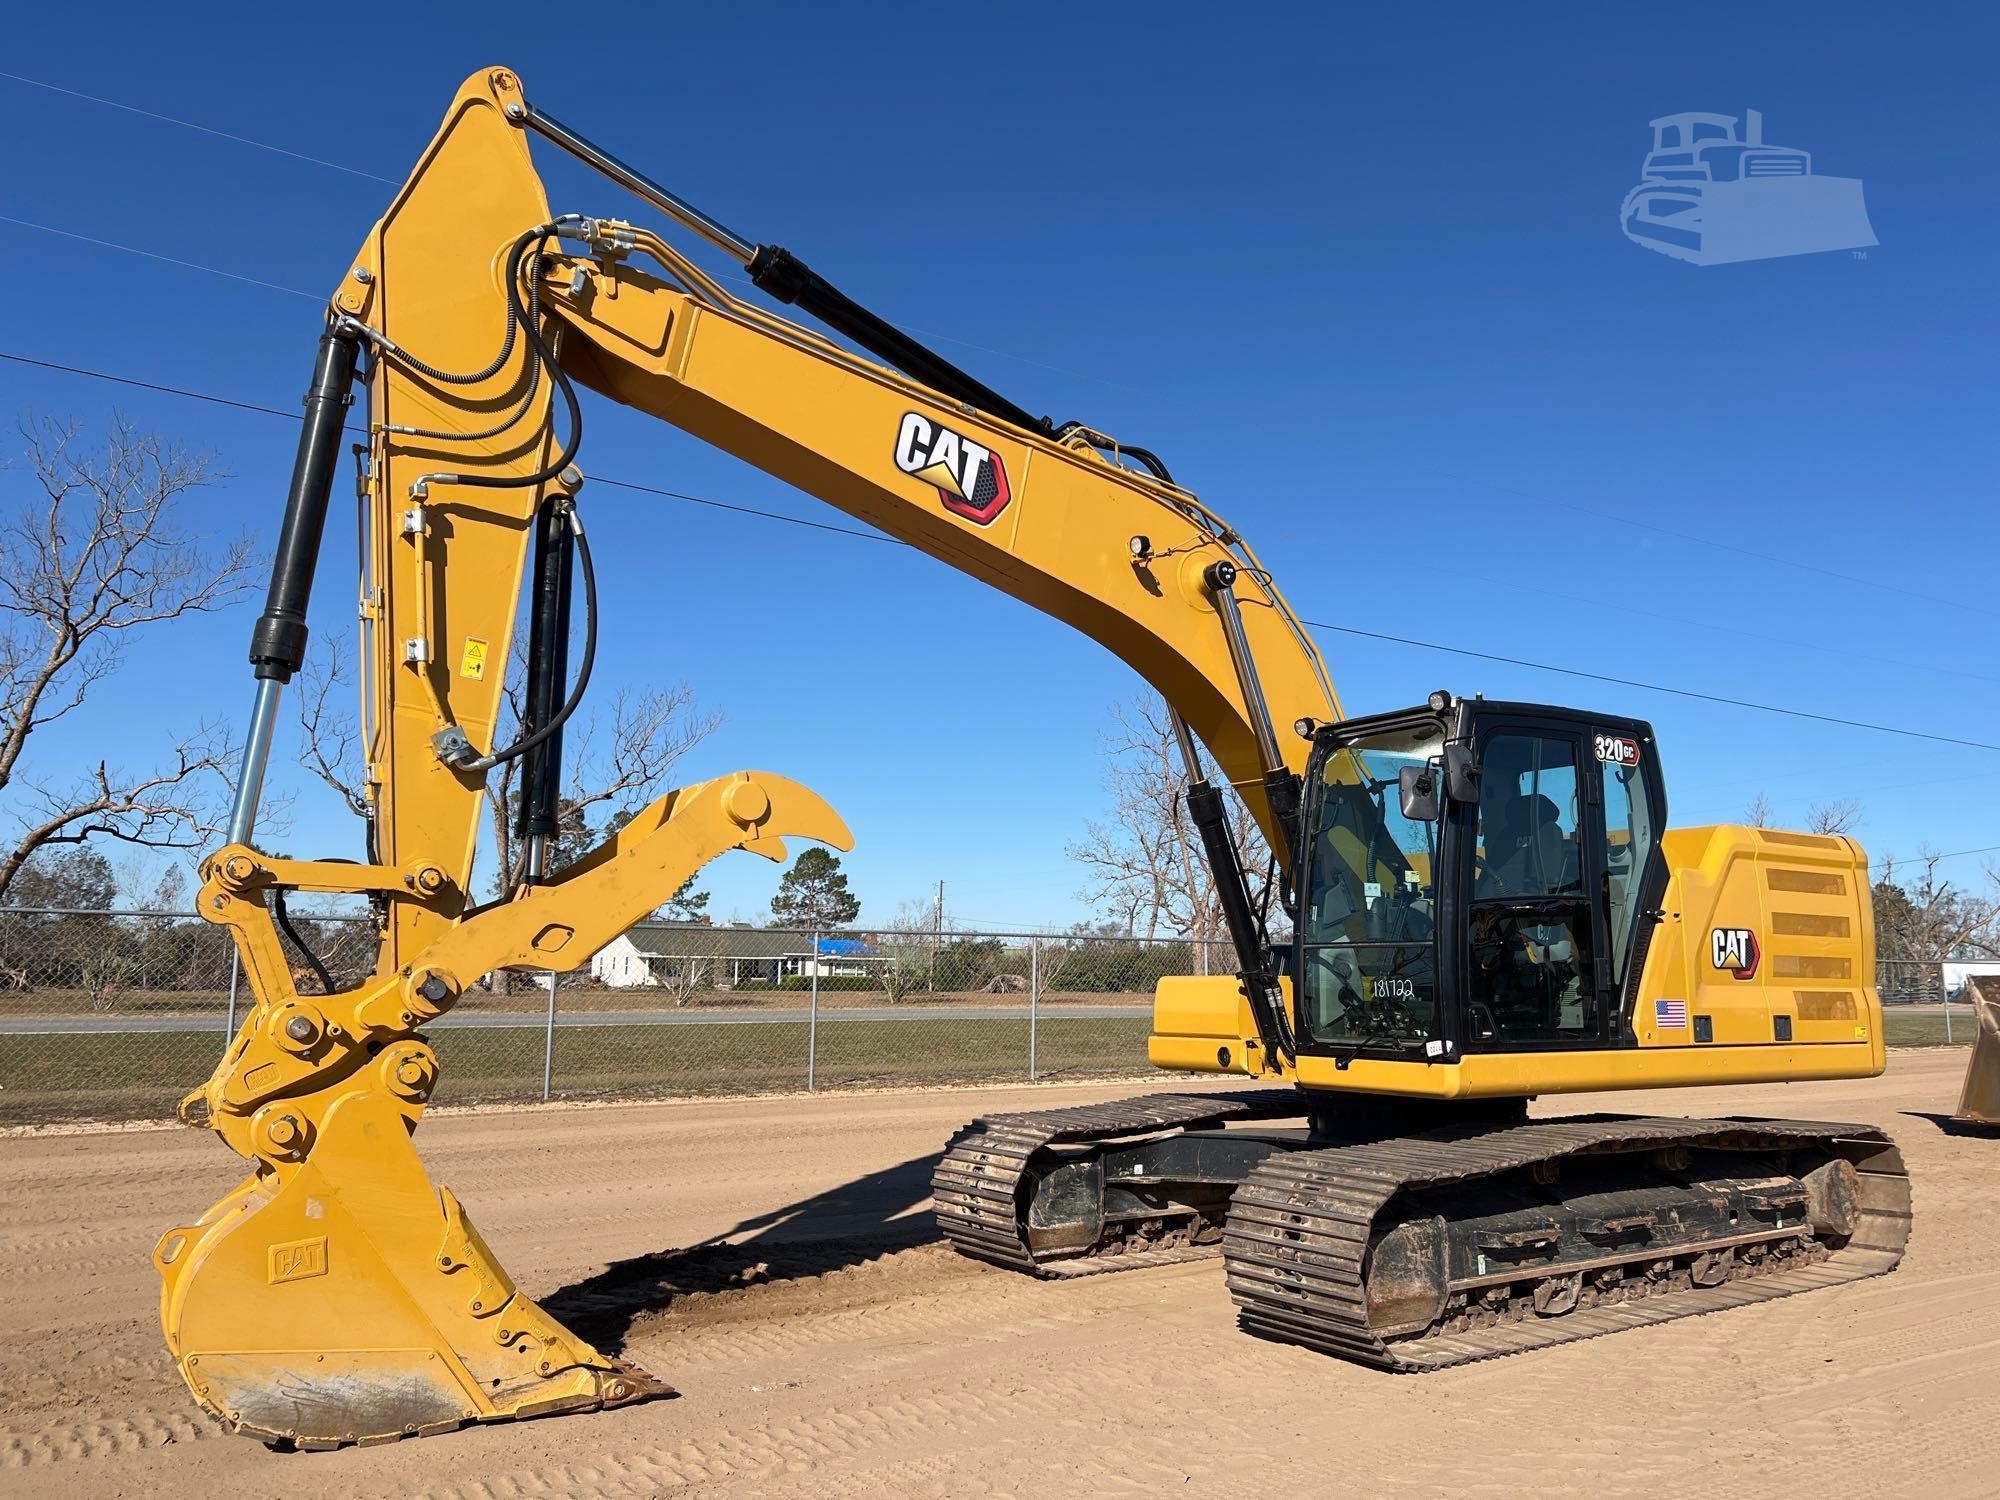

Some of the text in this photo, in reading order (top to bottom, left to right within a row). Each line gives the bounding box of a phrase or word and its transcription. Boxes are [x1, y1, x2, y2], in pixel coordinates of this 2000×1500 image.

[895, 412, 990, 502] CAT
[1595, 736, 1634, 762] 320 GC
[1712, 929, 1749, 968] CAT
[1374, 979, 1415, 998] 181722
[275, 1243, 323, 1279] CAT
